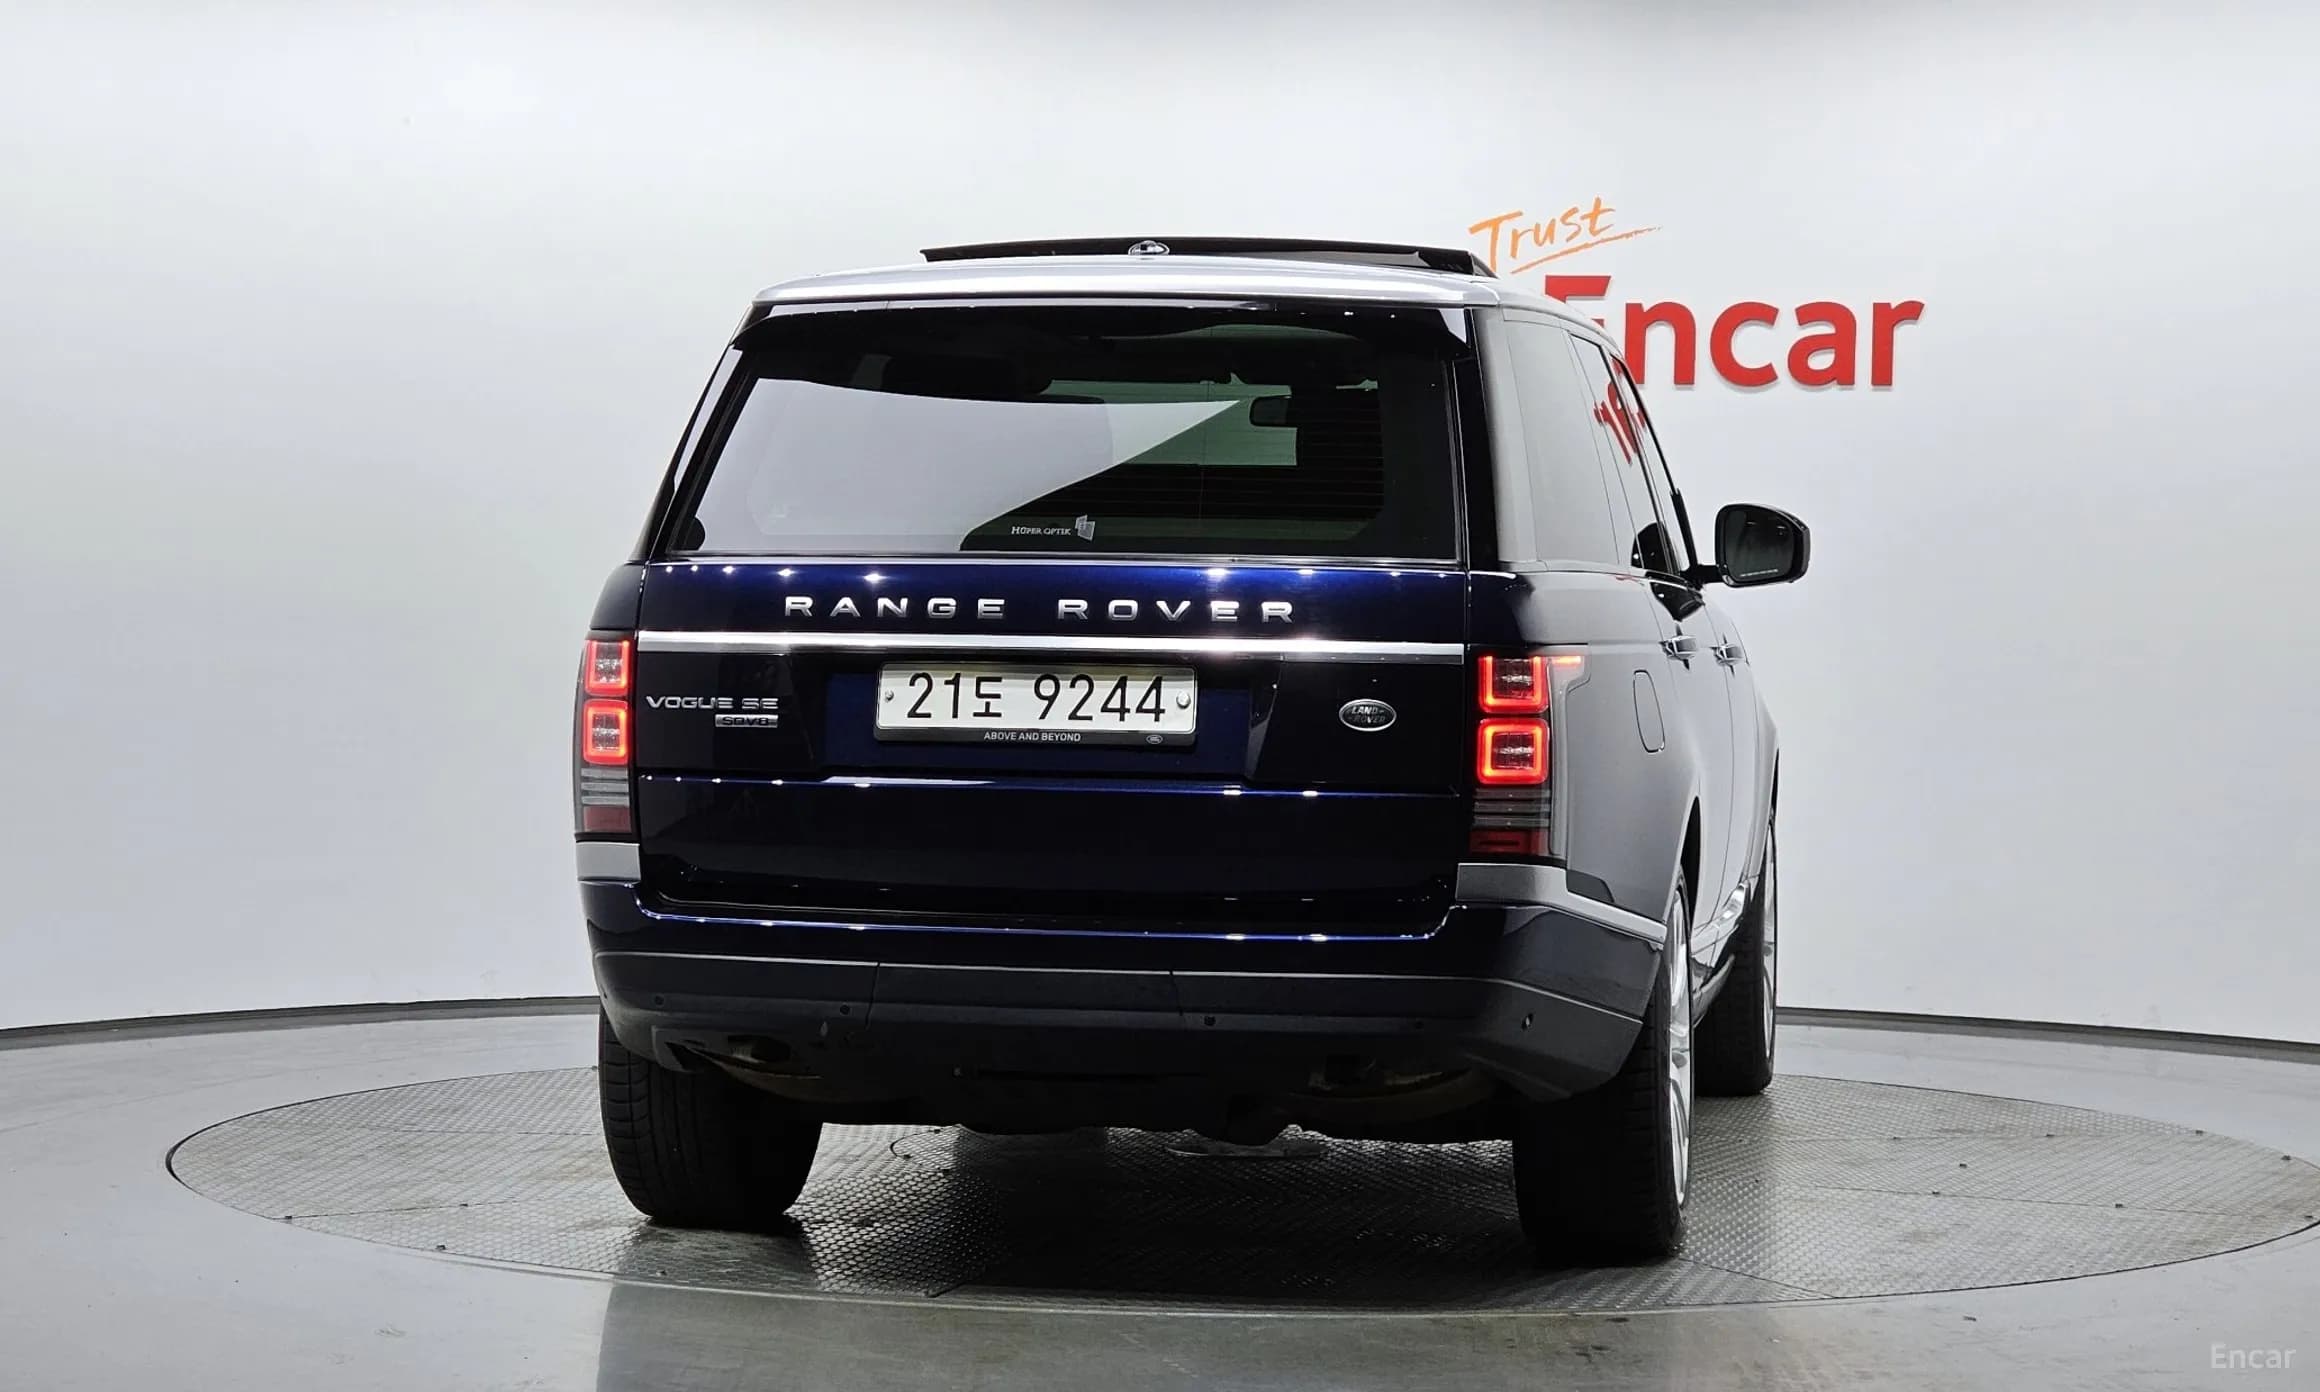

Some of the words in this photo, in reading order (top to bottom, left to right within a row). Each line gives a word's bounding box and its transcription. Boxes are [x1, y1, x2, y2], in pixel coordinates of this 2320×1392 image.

[1469, 197, 1616, 271] Trust
[1043, 527, 1071, 536] OPTIK
[784, 596, 1005, 619] RANGE
[1057, 599, 1293, 623] ROVER
[646, 696, 734, 709] VOGUE
[741, 698, 779, 709] SE
[906, 672, 1003, 719] 21도
[1033, 673, 1166, 722] 9244
[721, 716, 770, 726] SDV8
[983, 731, 1017, 741] ABOVE
[1018, 732, 1039, 741] AND
[1041, 732, 1081, 742] BEYOND
